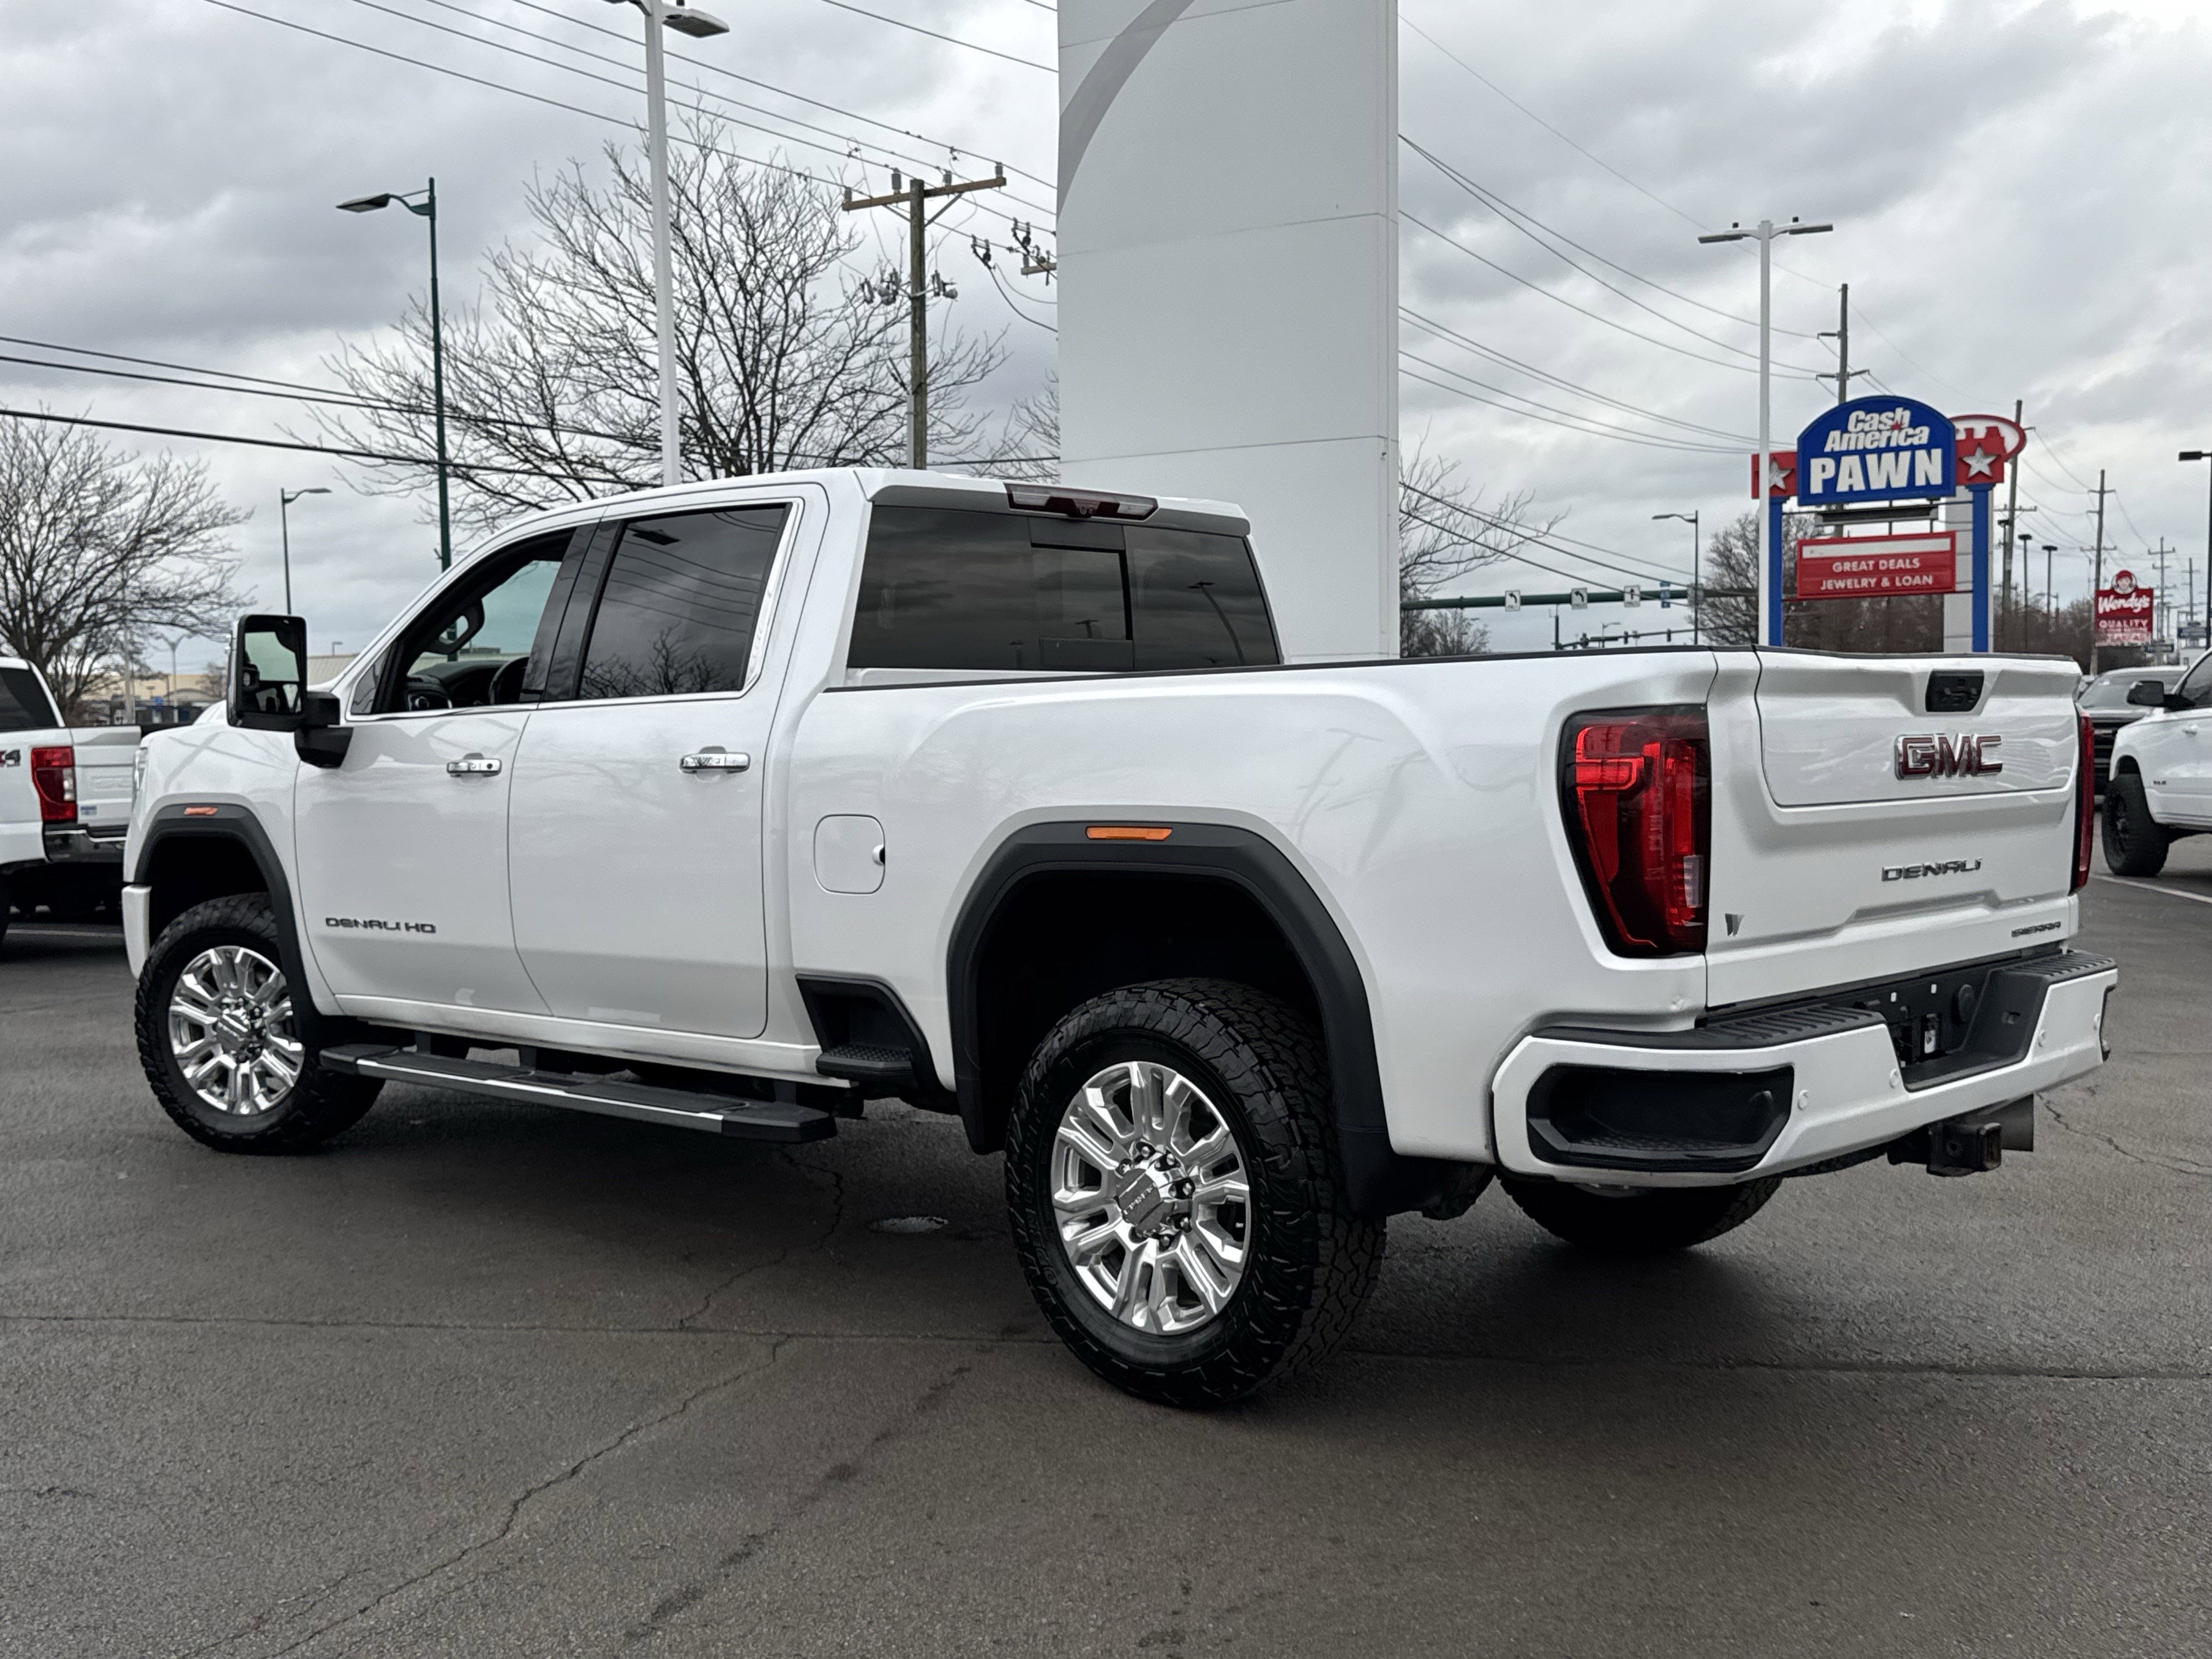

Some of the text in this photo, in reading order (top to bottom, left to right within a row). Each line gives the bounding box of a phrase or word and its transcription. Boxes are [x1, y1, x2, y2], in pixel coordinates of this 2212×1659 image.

[1847, 407, 1911, 432] Cash
[1824, 425, 1930, 453] America
[1809, 448, 1943, 494] PAWN
[1832, 557, 1921, 573] GREAT DEALS
[1820, 574, 1933, 591] JEWELRY & LOAN
[2098, 592, 2151, 614] Wendy's
[1894, 733, 2004, 780] GMC
[1881, 856, 1982, 882] DENALI
[325, 917, 436, 933] DENALI HD
